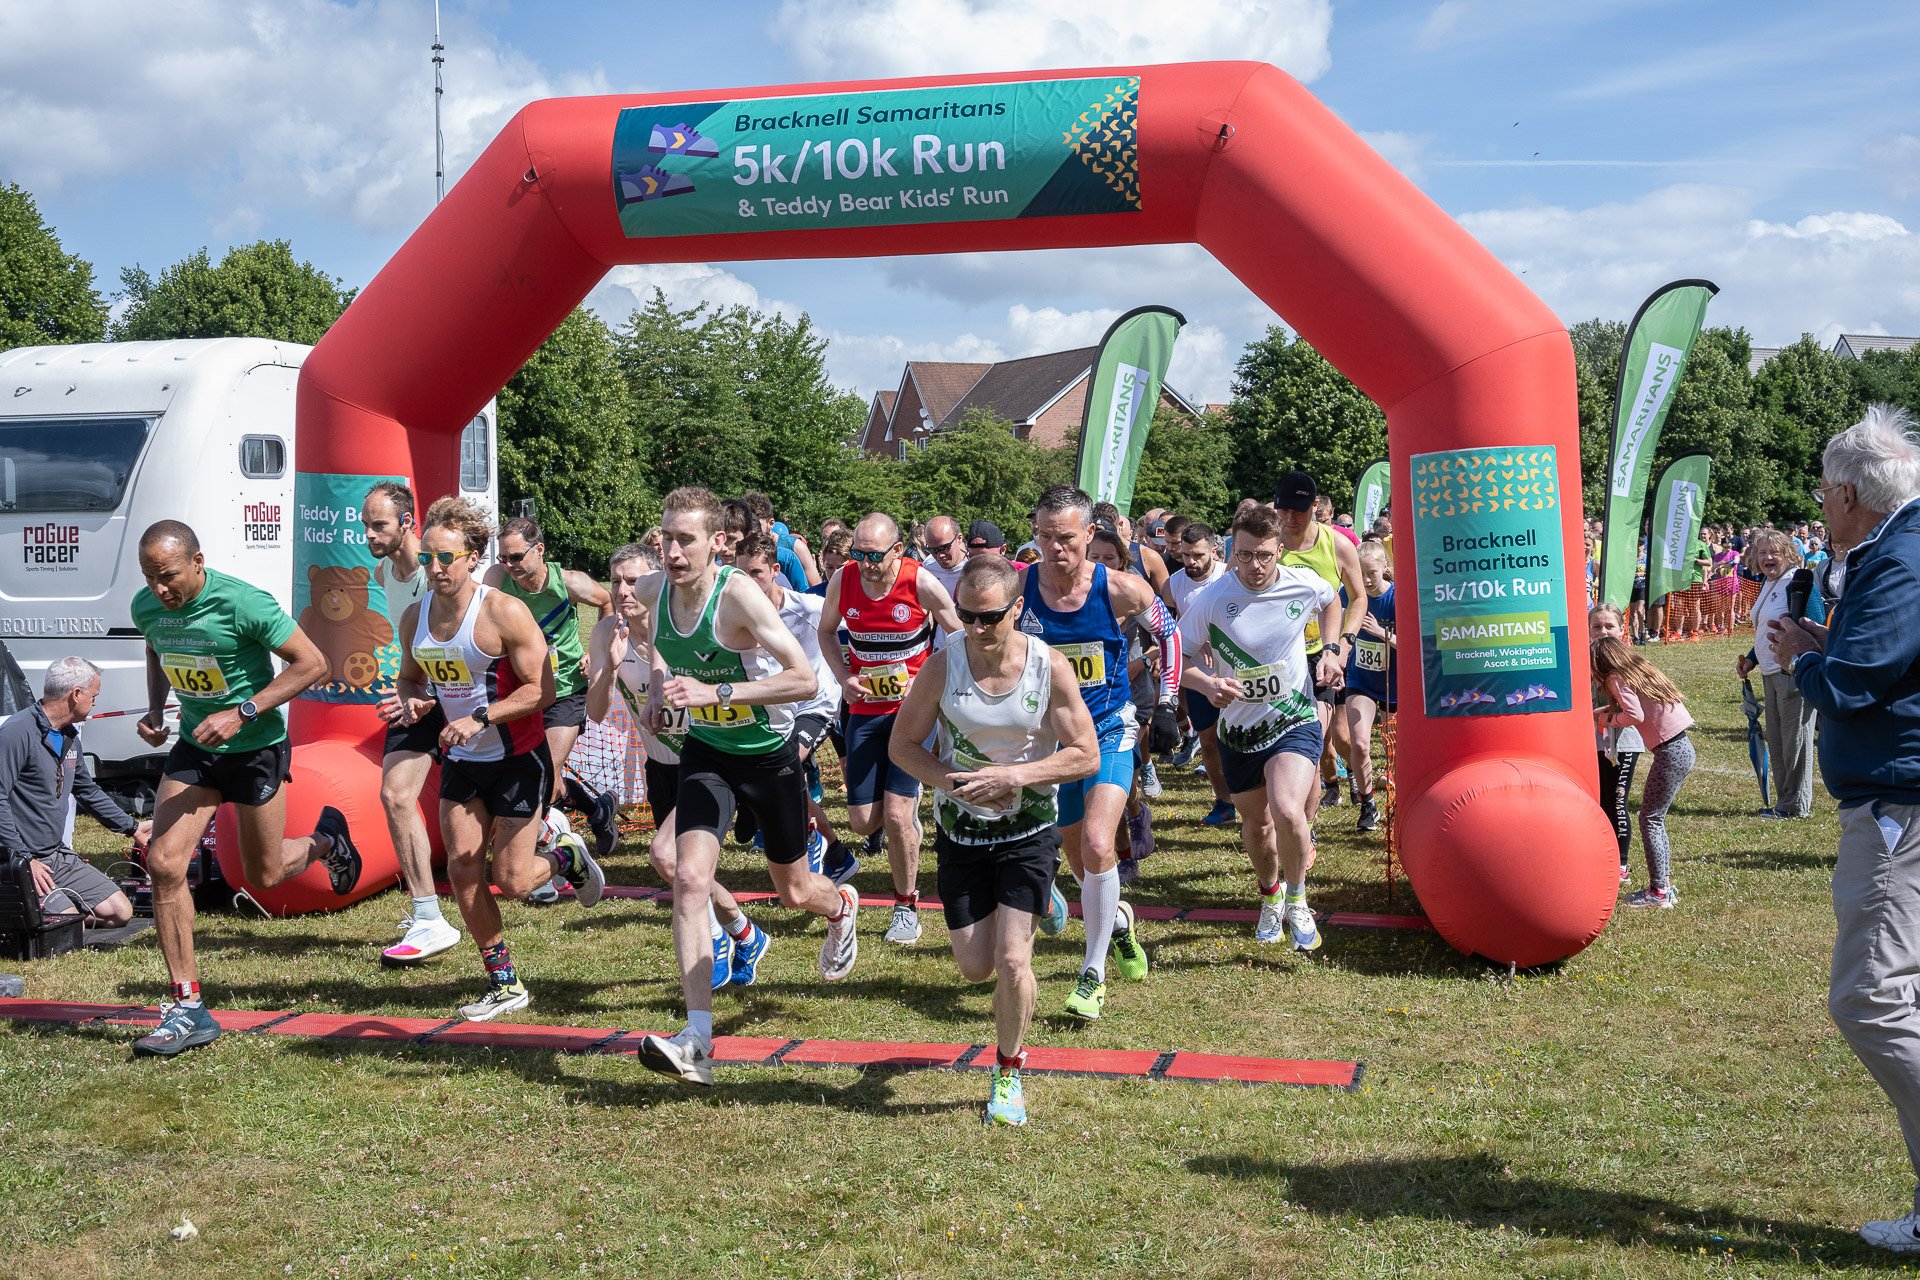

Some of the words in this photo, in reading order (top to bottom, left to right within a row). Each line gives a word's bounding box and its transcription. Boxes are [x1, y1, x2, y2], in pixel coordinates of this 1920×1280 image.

[735, 108, 849, 132] Bracknell
[856, 102, 1006, 125] Samaritans
[733, 137, 899, 186] 5k/10k
[913, 134, 1005, 175] Run
[738, 199, 758, 218] &
[761, 195, 832, 218] Teddy
[839, 193, 893, 212] Bear
[900, 187, 955, 208] Kids'
[963, 186, 1009, 205] Run
[1617, 353, 1672, 489] SAMARITANS
[300, 505, 340, 525] Teddy
[1669, 485, 1690, 566] SAMARITANS
[244, 524, 281, 541] racer
[304, 527, 337, 543] Kids'
[343, 529, 367, 544] Ru
[1442, 529, 1536, 552] Bracknell
[24, 545, 79, 563] racer
[1433, 553, 1549, 575] Samaritans
[1434, 579, 1507, 602] 5k/10k
[1512, 578, 1551, 596] Run
[0, 618, 104, 636] EQUI-TREK
[852, 633, 907, 641] MAIDENHEAD
[1441, 620, 1546, 641] SAMARITANS
[889, 651, 910, 659] CLUB
[1359, 649, 1382, 666] 384
[1455, 649, 1497, 659] Bracknell,
[1499, 646, 1552, 658] Wokingham,
[1483, 660, 1509, 668] Ascot
[1511, 658, 1518, 667] &
[1520, 656, 1553, 665] Districts
[174, 668, 213, 692] 163
[869, 676, 902, 697] 168
[1242, 675, 1280, 699] 350
[1615, 797, 1627, 839] MAGICAL
